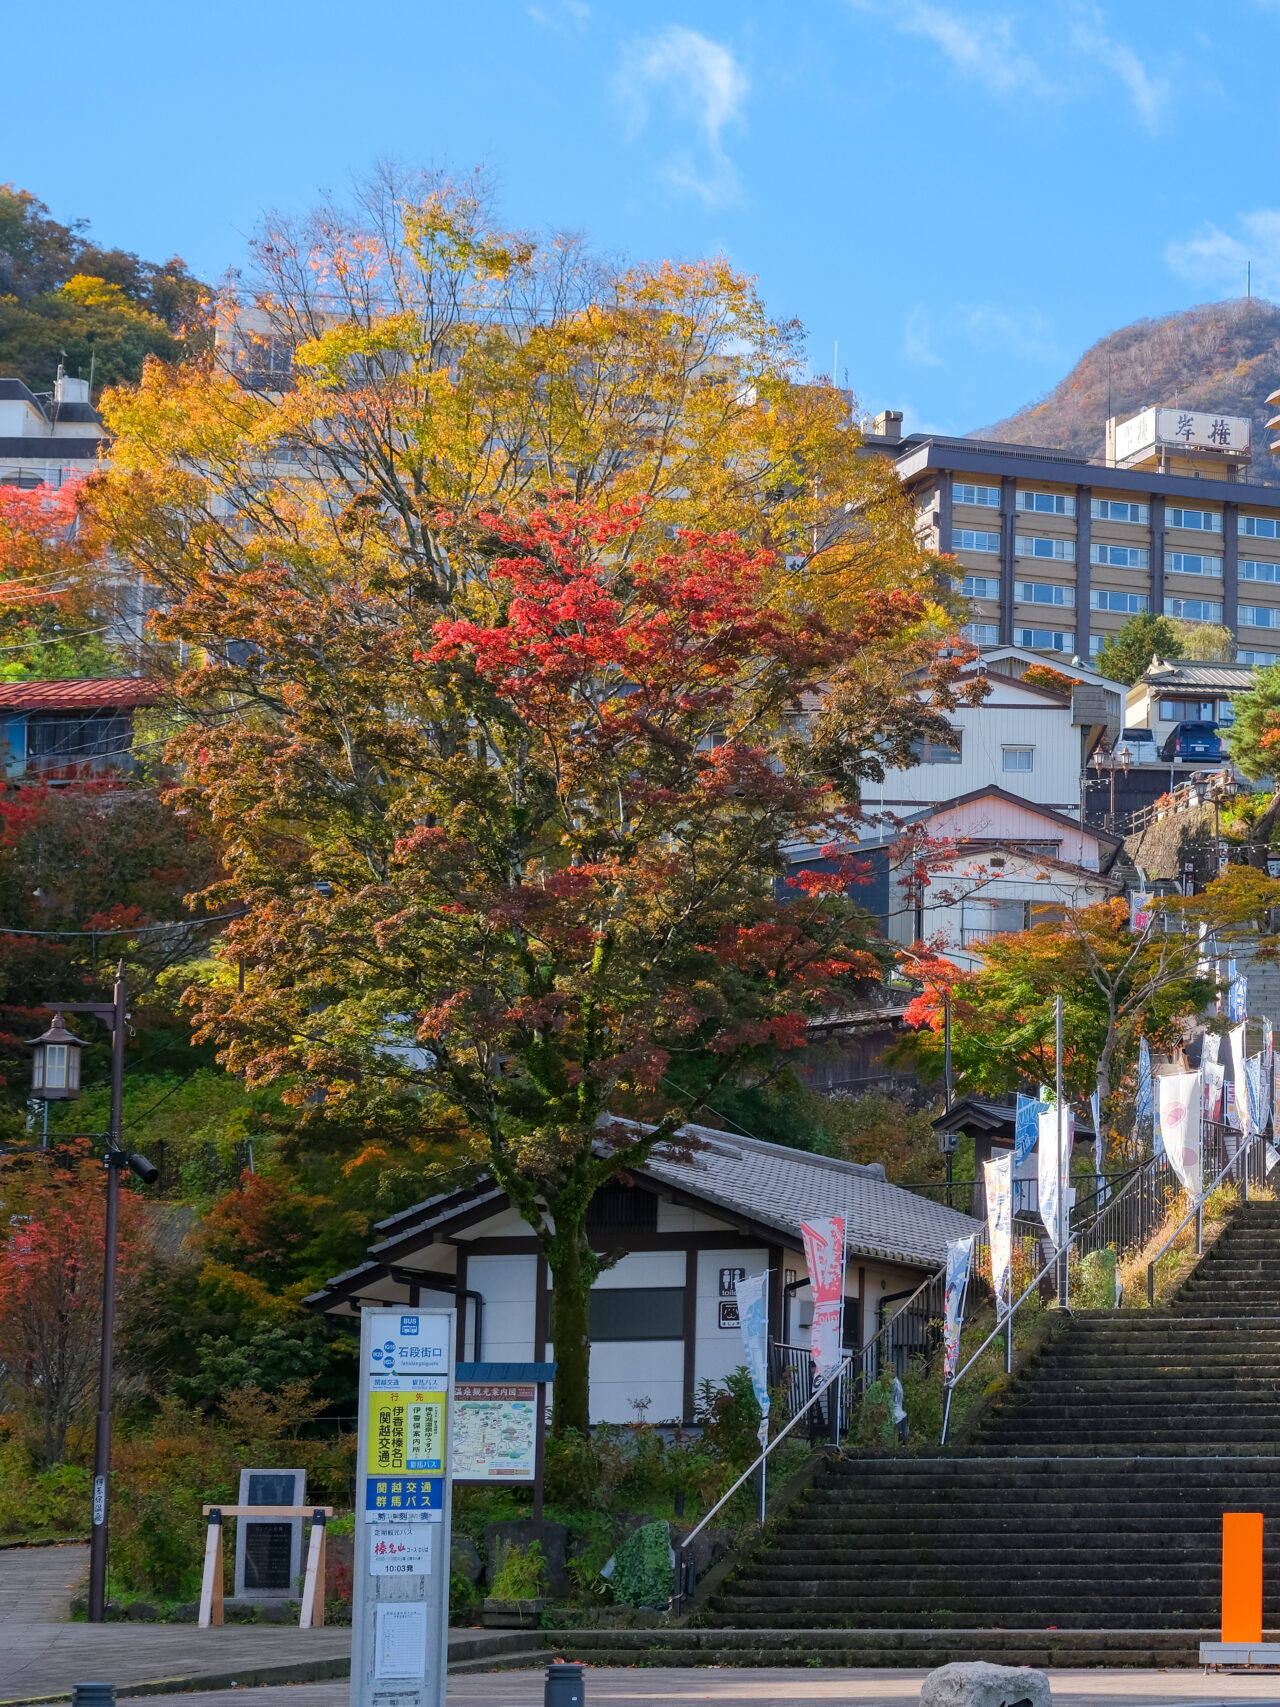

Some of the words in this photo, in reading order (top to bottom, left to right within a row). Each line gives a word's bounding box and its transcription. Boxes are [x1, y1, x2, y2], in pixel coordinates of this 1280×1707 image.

[398, 1346, 442, 1358] 石段街口
[391, 1406, 404, 1468] 伊香保榛名口
[376, 1482, 432, 1493] 関越交通
[376, 1496, 431, 1507] 群馬バス
[385, 1564, 414, 1573] 10:03発
